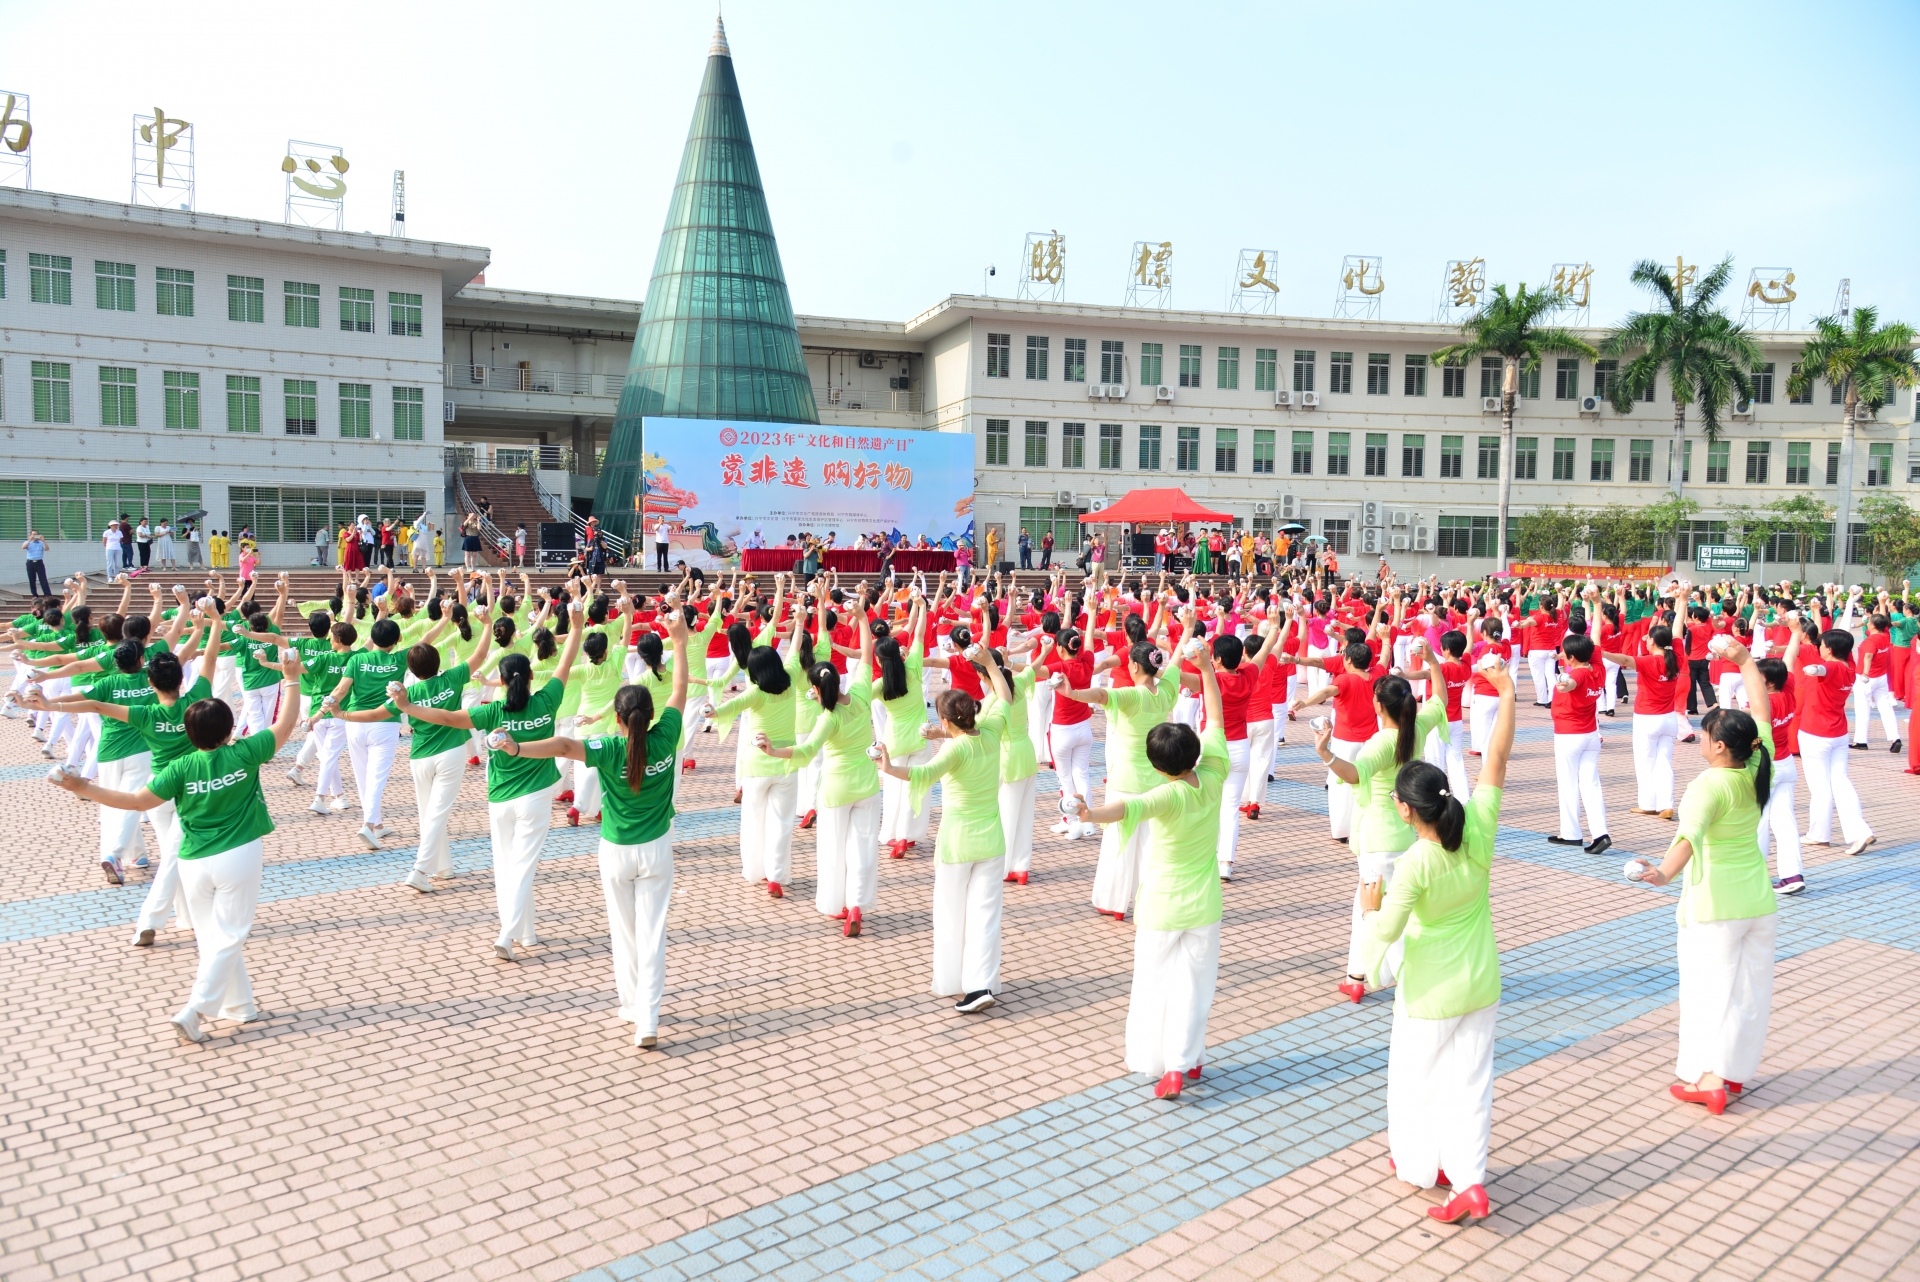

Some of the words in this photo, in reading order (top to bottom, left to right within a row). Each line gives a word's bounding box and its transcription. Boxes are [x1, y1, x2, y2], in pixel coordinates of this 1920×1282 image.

[720, 452, 810, 488] 赏非遗
[823, 459, 913, 491] 购好物
[359, 663, 398, 674] 3trees
[155, 721, 186, 733] 3tre
[501, 713, 552, 732] 3trees
[185, 768, 248, 795] 3trees
